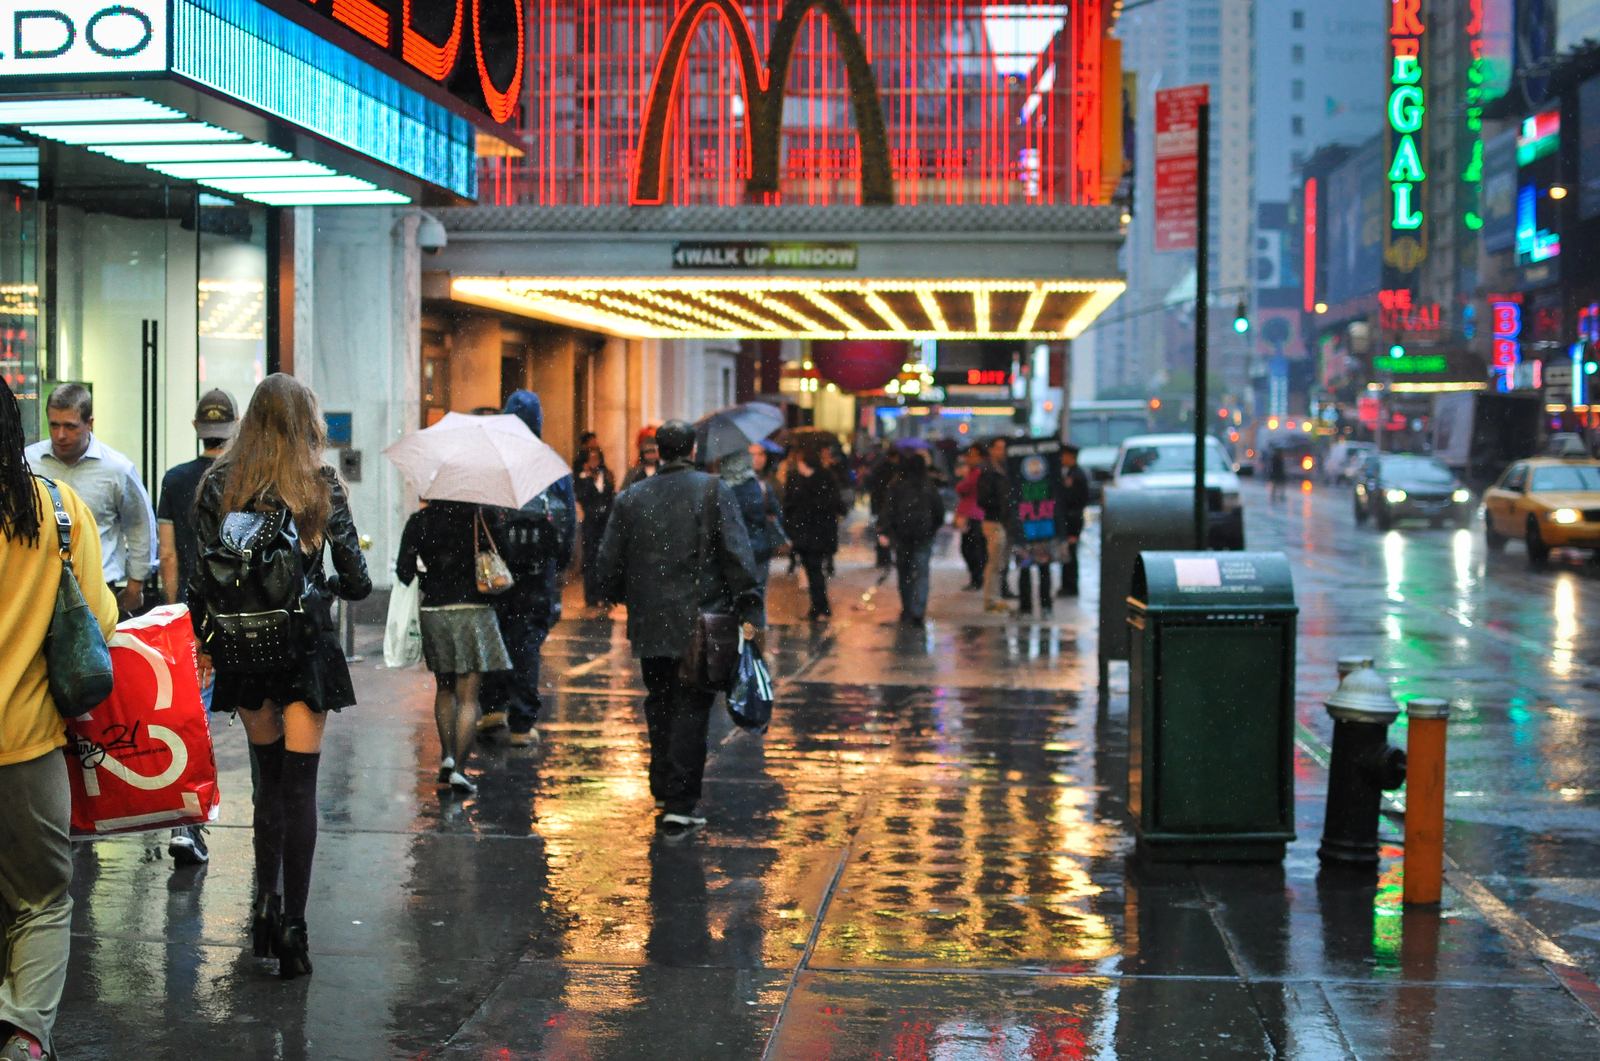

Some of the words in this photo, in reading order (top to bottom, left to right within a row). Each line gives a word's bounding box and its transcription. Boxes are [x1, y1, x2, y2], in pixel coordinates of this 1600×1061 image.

[1387, 0, 1426, 230] REGAL
[687, 247, 739, 265] WALK
[743, 247, 770, 265] UP
[774, 247, 856, 265] WINDOW
[102, 719, 140, 749] 21
